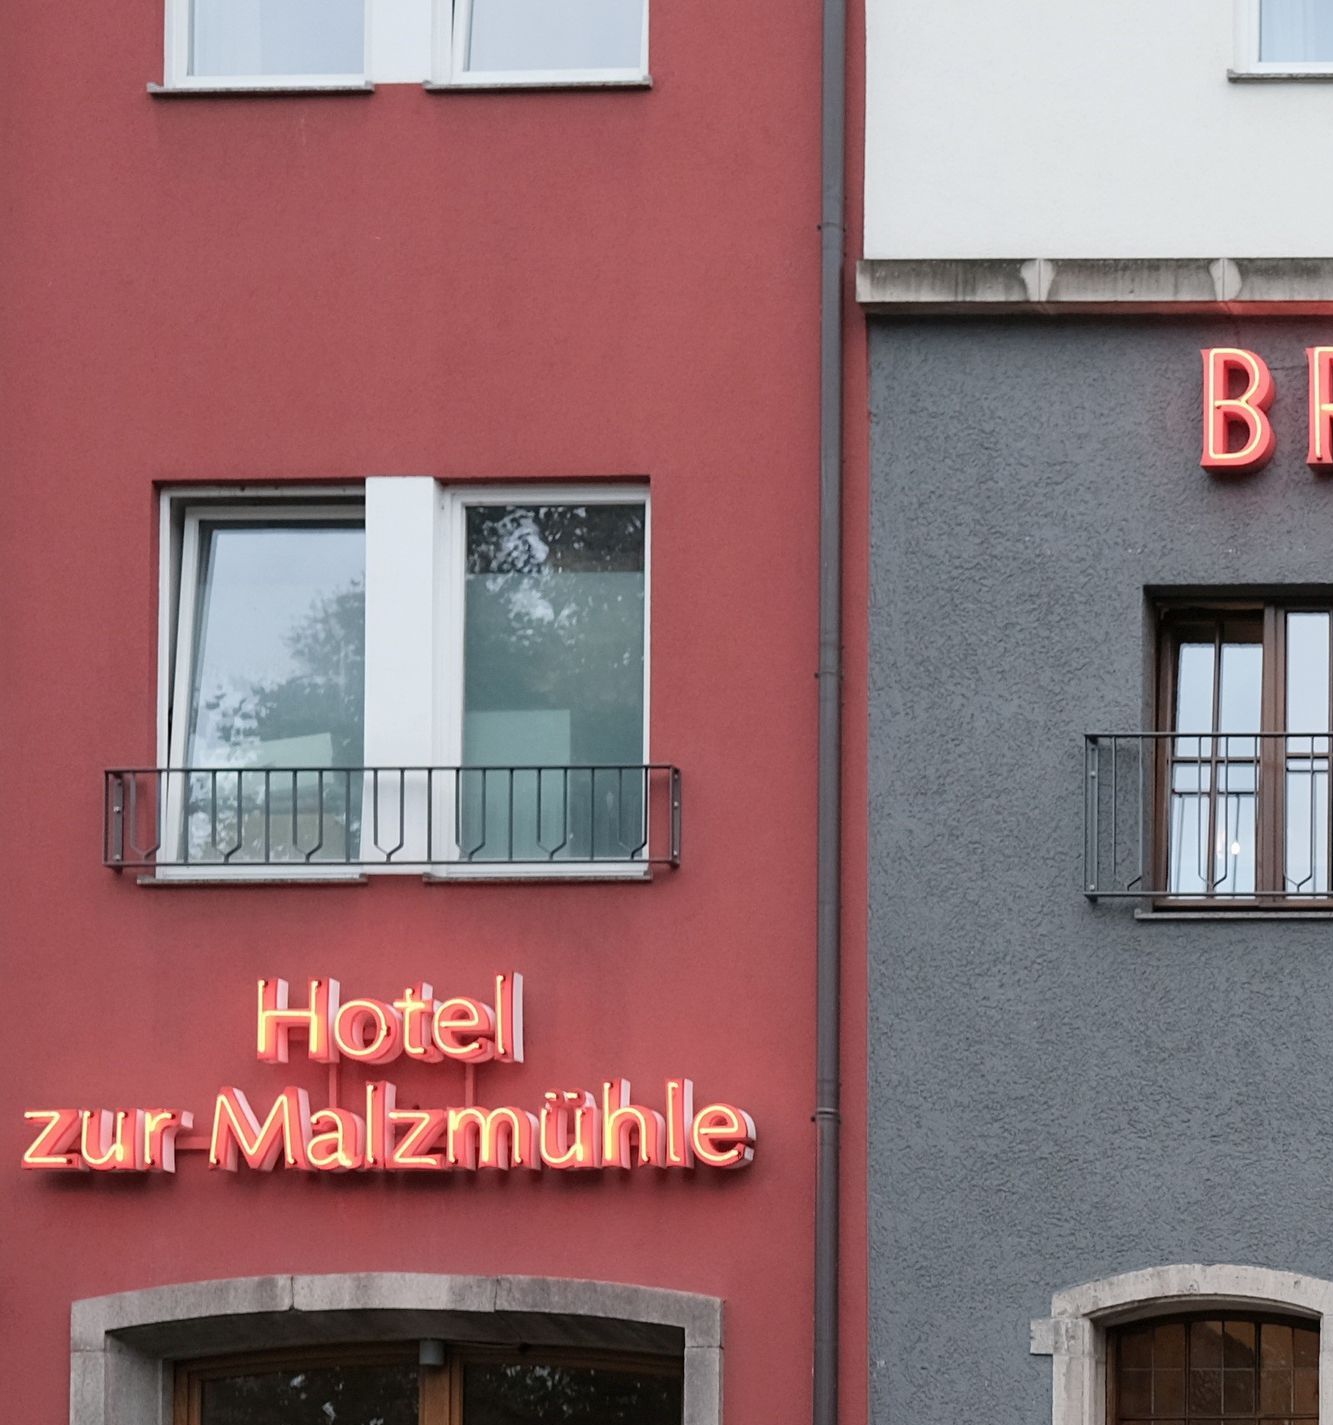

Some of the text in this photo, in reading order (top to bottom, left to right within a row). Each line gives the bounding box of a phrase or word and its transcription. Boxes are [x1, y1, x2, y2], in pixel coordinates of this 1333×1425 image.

[257, 970, 524, 1064] Hotel
[20, 1077, 757, 1173] zur Malzmühle
